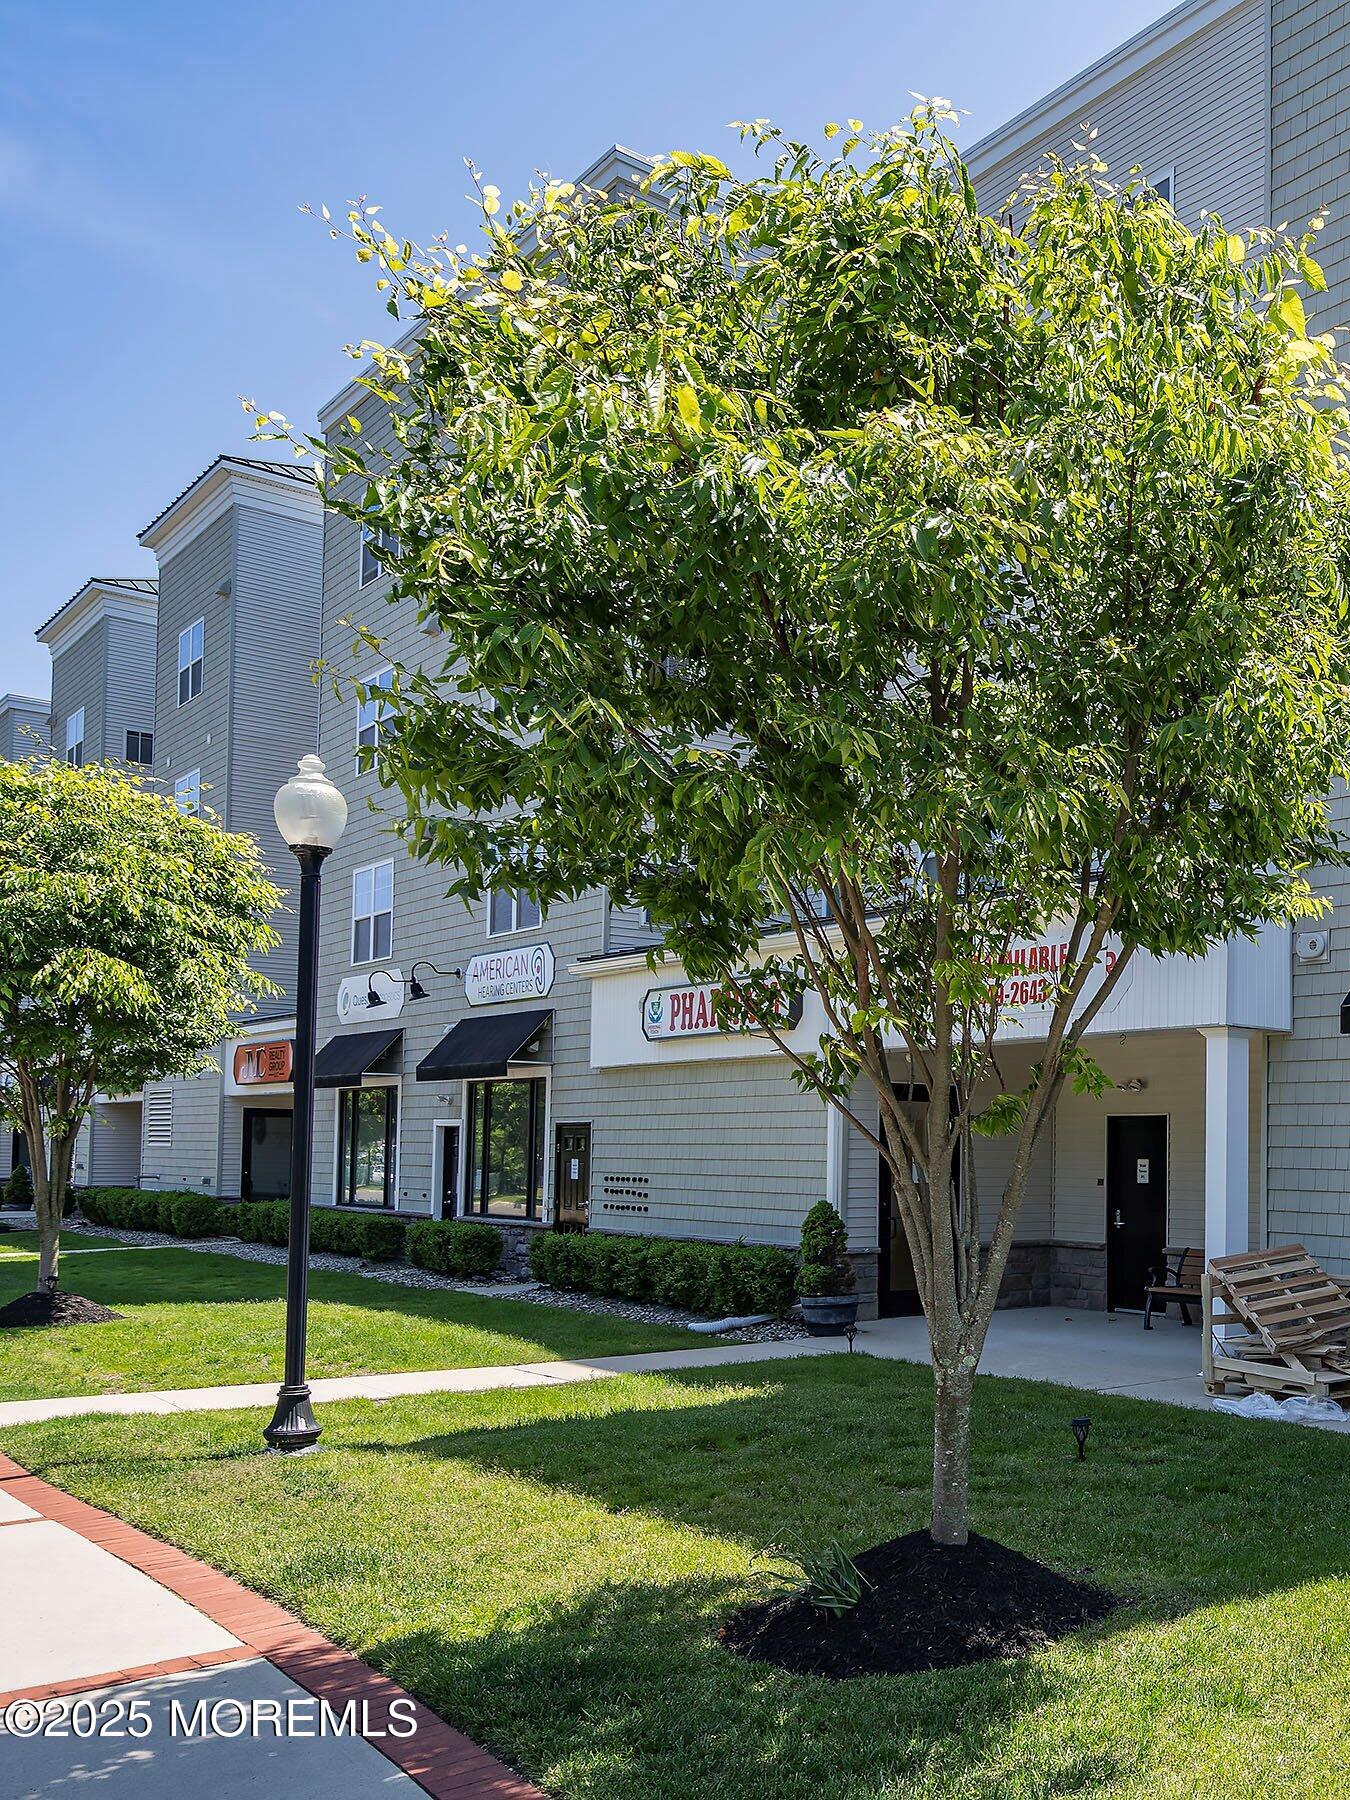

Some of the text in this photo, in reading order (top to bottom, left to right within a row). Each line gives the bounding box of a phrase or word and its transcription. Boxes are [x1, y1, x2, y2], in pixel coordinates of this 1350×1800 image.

[472, 953, 529, 983] AMERICAN
[478, 979, 534, 999] HEARING CENTERS
[353, 994, 369, 1007] Ques
